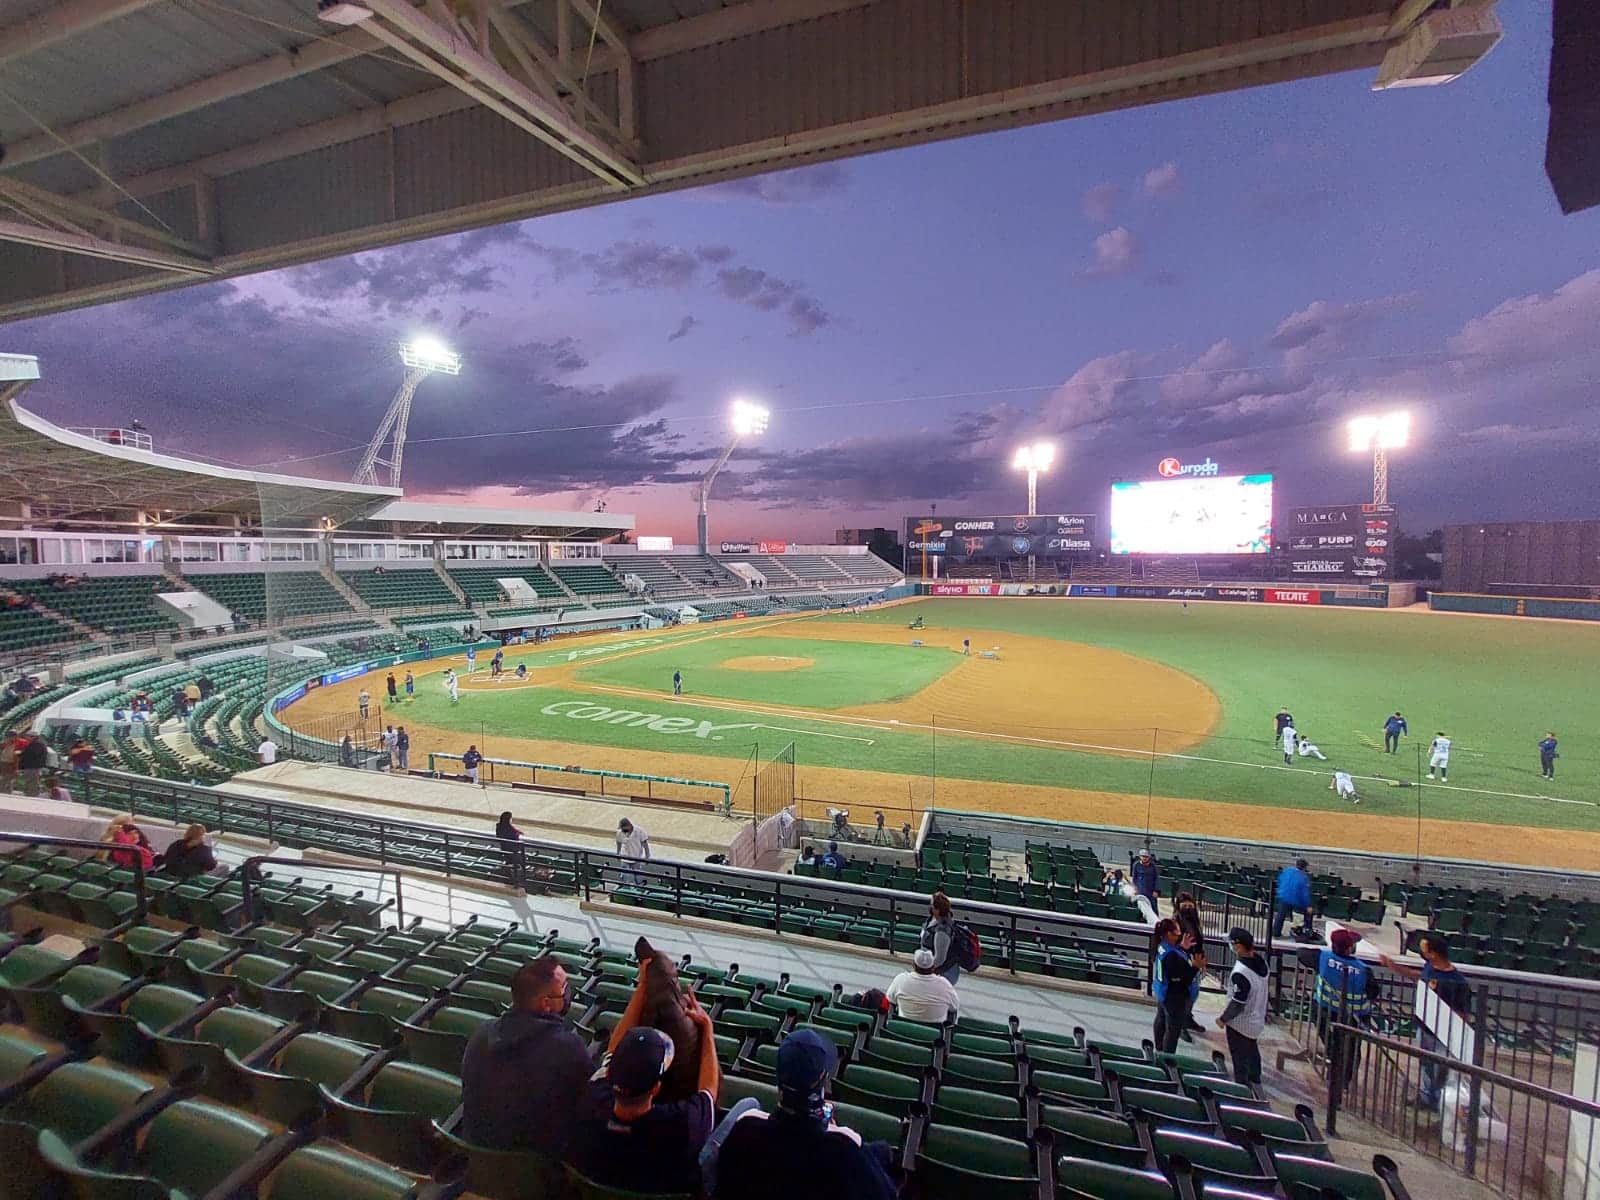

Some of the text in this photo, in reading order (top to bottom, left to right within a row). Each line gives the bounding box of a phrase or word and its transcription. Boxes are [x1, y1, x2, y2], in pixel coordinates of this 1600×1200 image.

[1160, 457, 1218, 476] Kuroda
[955, 521, 994, 530] GONHER
[1319, 536, 1354, 544] PURP
[1275, 591, 1310, 601] TECATE
